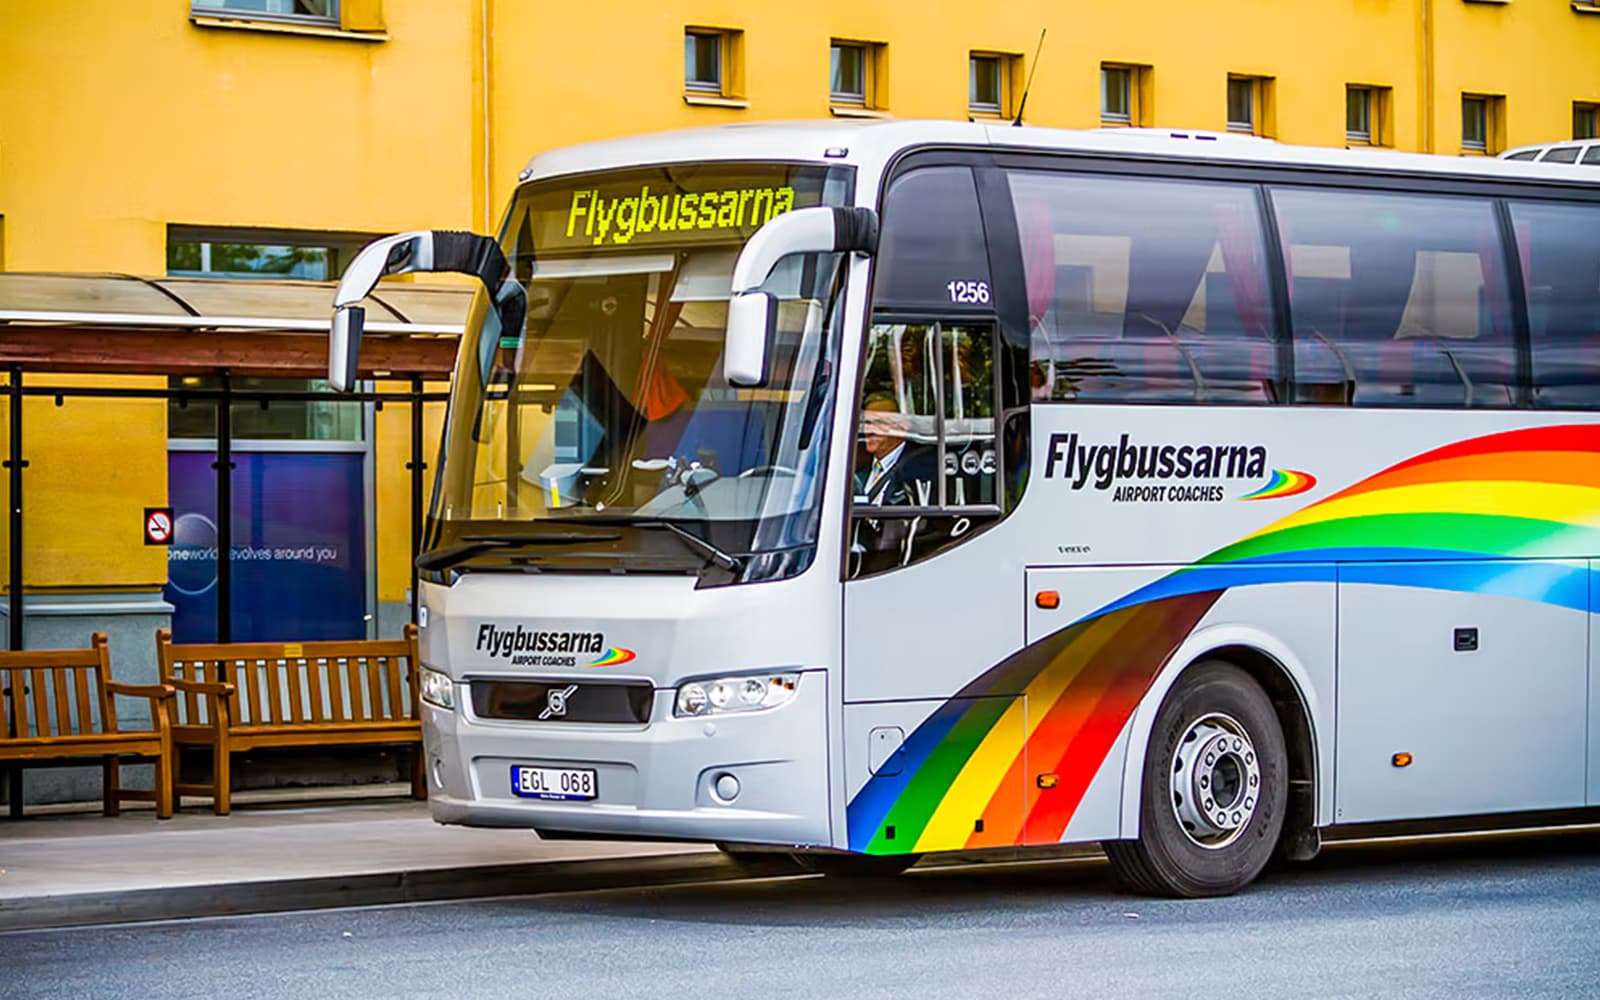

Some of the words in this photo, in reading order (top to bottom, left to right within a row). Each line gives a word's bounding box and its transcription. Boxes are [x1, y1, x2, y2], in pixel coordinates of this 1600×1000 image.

[566, 186, 794, 245] Flygbussarna
[947, 281, 990, 303] 1256
[1044, 433, 1267, 490] Flygbussarna
[1112, 485, 1167, 502] AIRPORT
[1167, 485, 1224, 502] COACHES
[229, 546, 272, 560] evolves
[273, 546, 314, 561] around
[314, 549, 337, 563] you
[476, 624, 604, 658] Flygbussarna
[511, 655, 542, 665] AIRPORT
[542, 656, 577, 667] COACHES
[521, 770, 550, 791] EGL
[560, 772, 591, 793] 068
